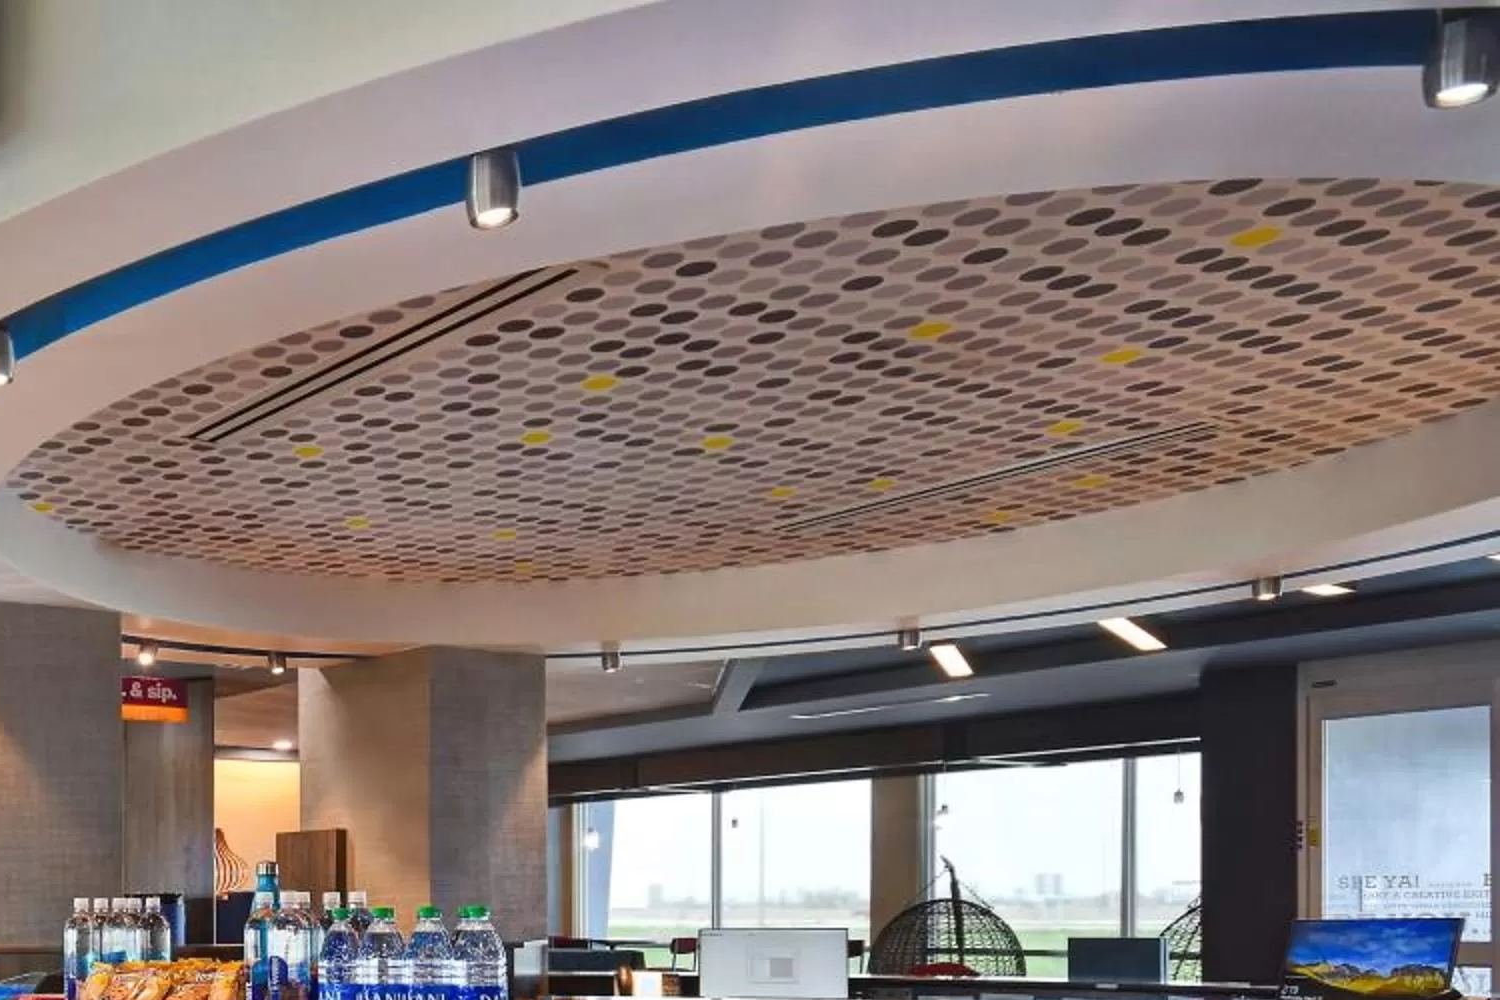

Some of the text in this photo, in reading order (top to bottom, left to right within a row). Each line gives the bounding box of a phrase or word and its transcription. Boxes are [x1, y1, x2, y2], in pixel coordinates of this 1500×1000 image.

[129, 681, 177, 704] & sip.
[1384, 875, 1420, 889] YA!
[1403, 890, 1461, 900] CREATIVE
